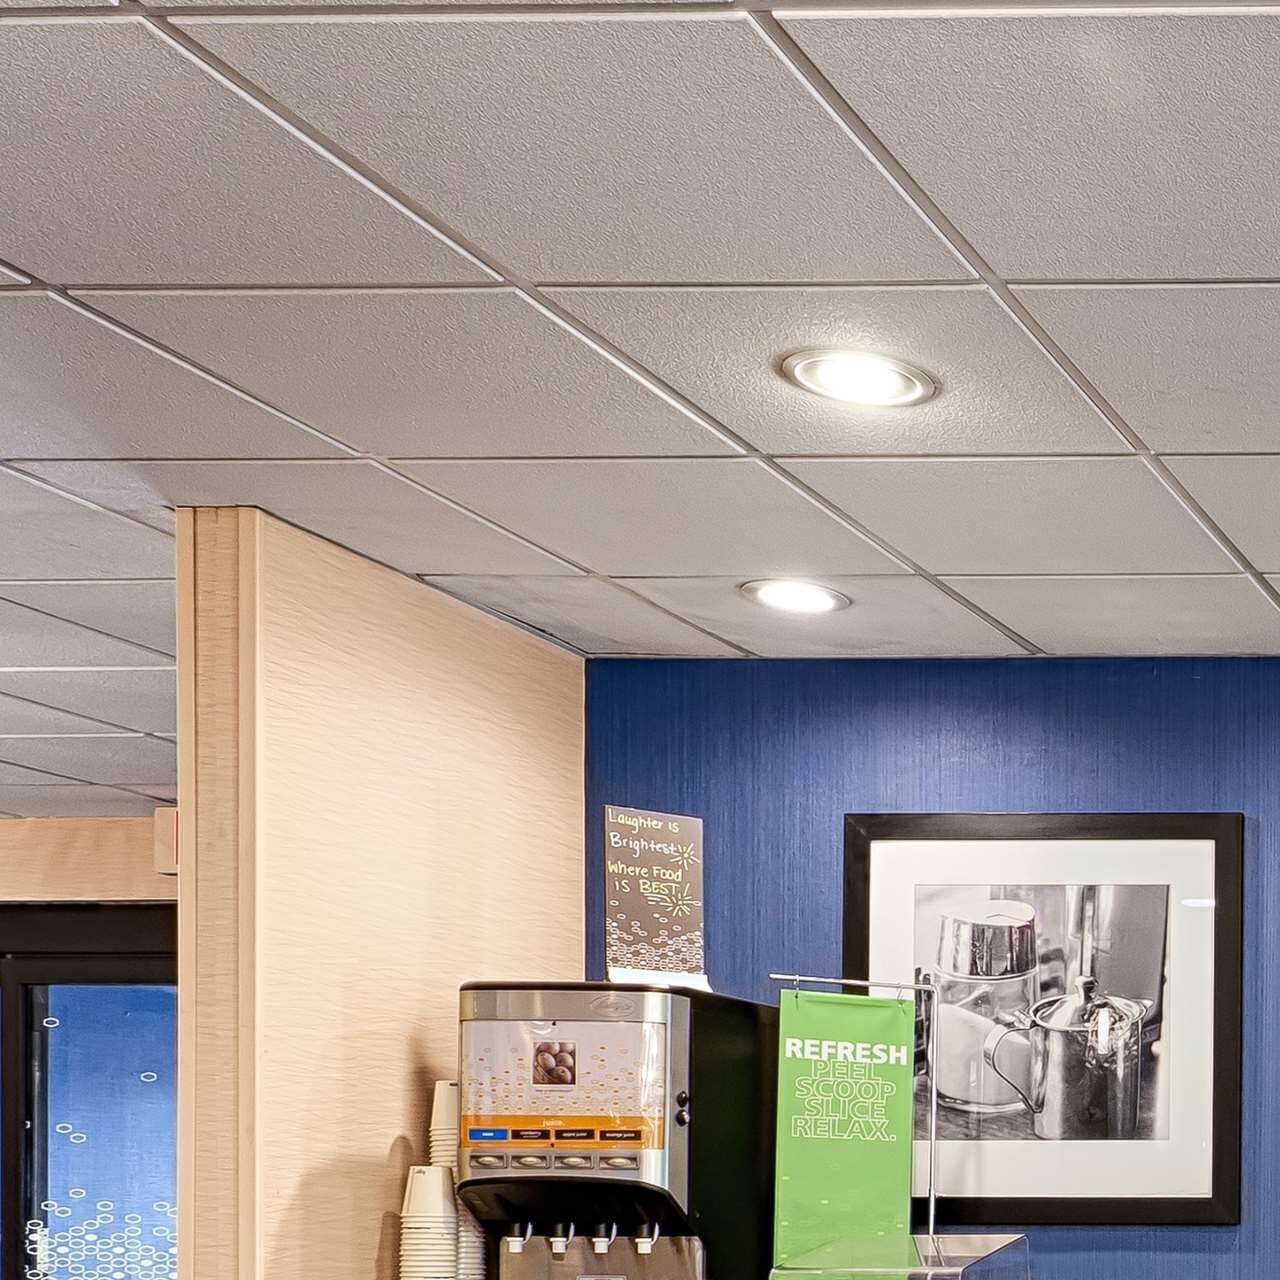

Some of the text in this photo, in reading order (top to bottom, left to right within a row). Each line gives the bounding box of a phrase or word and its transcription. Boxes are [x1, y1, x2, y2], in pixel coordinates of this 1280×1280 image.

[608, 808, 663, 834] Laughter
[609, 831, 679, 858] Brightest
[652, 866, 682, 882] Food
[784, 1037, 908, 1066] REFRESH
[811, 1059, 882, 1082] PEEL
[795, 1076, 897, 1102] SCOOP
[804, 1097, 888, 1122] SLICE
[791, 1115, 898, 1142] RELAX.
